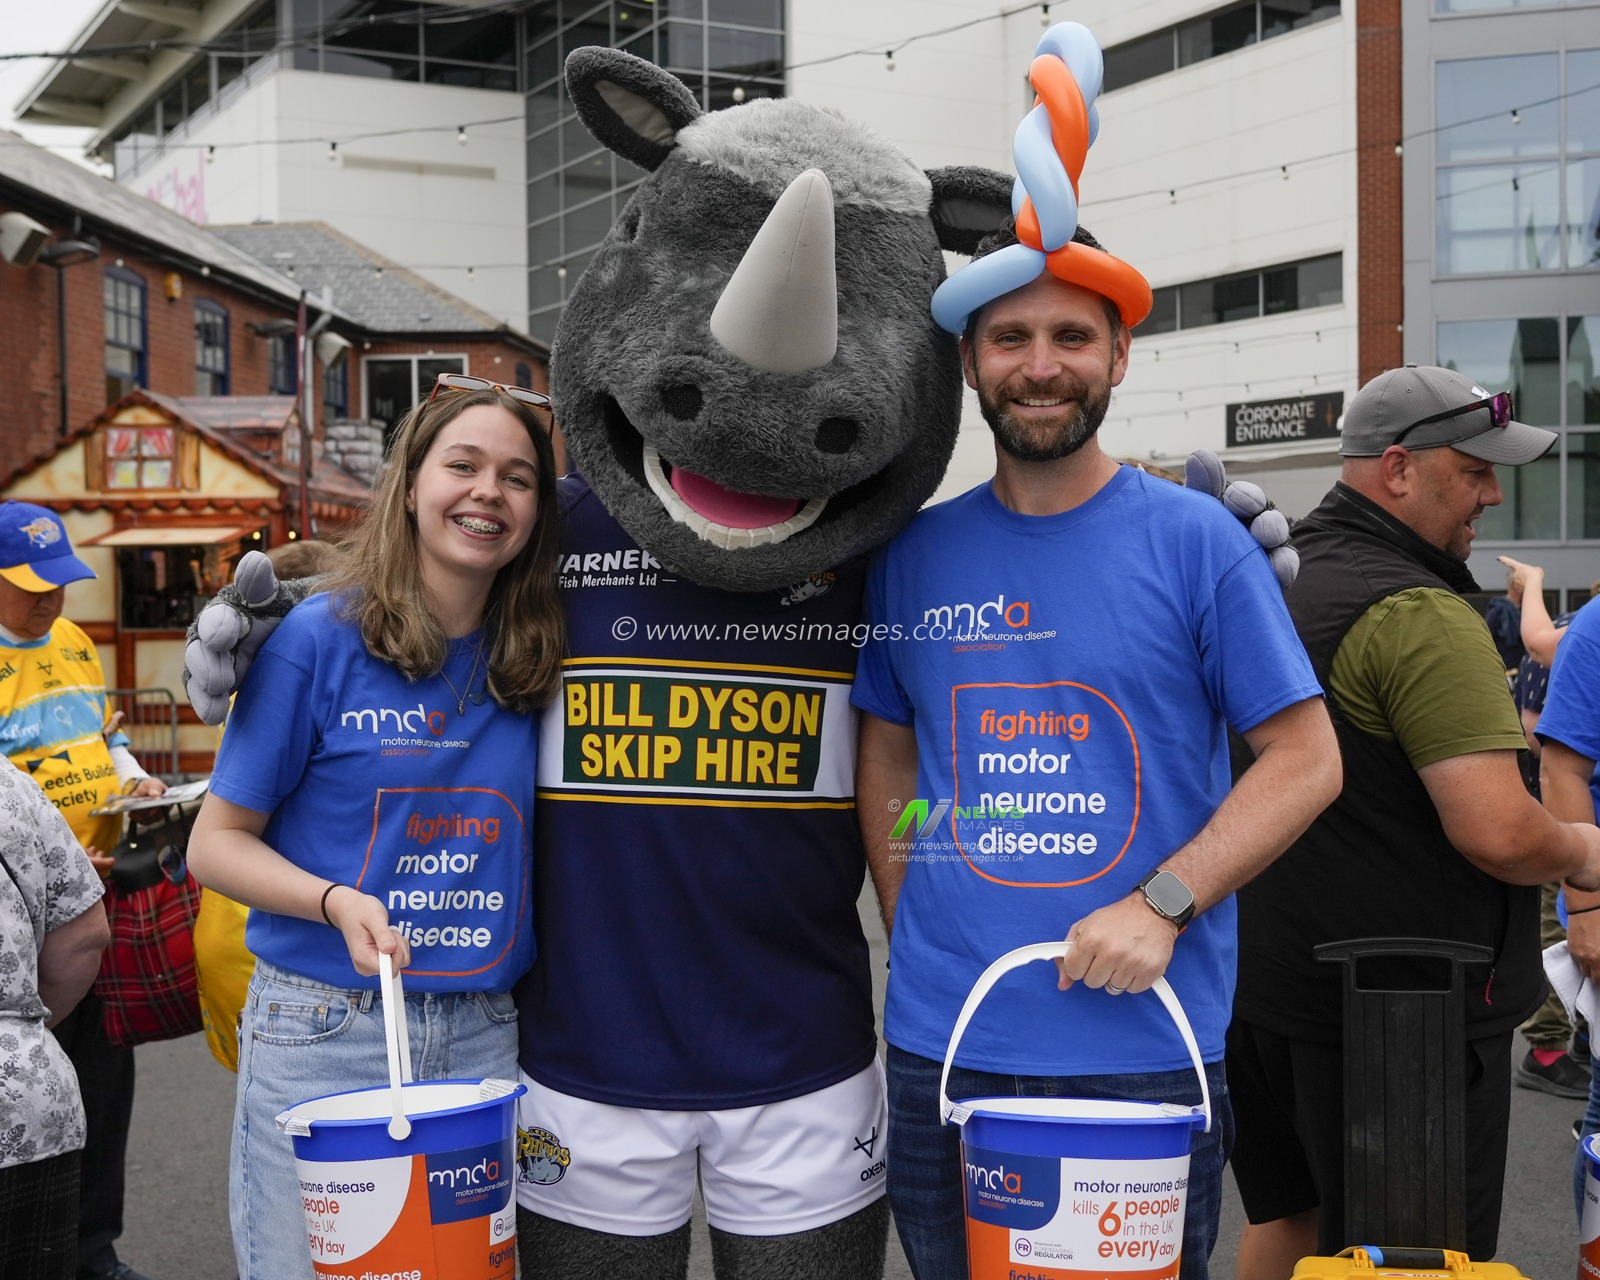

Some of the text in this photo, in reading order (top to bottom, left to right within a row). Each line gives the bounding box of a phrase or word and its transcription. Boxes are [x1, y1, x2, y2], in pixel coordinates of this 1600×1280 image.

[1235, 401, 1316, 425] CORPORATE
[1235, 420, 1307, 442] ENTRANCE
[559, 573, 657, 588] Fish Merchants Ltd
[924, 595, 1030, 630] mnda
[981, 633, 1023, 641] neurone
[1024, 630, 1057, 641] disease
[952, 643, 1006, 653] association
[341, 703, 446, 735] mnda
[566, 682, 821, 737] BILL DYSON
[980, 709, 1090, 741] fighting
[381, 736, 470, 748] motor neurone disease
[580, 733, 801, 785] SKIP HIRE
[978, 747, 1071, 774] motor
[42, 771, 82, 792] eeds
[51, 789, 98, 808] ociety
[979, 792, 1107, 815] neurone
[406, 813, 500, 845] fighting
[978, 827, 1098, 856] disease
[395, 849, 479, 875] motor
[388, 889, 504, 911] neurone
[429, 1157, 499, 1188] mnda
[860, 1158, 886, 1181] OXEN
[965, 1162, 1022, 1194] mnda
[326, 1181, 375, 1193] disease
[1074, 1180, 1121, 1194] motor
[1124, 1180, 1173, 1194] neurone
[1017, 1197, 1045, 1208] disease
[322, 1219, 337, 1233] UK
[1072, 1194, 1180, 1237] kills 6 people
[1123, 1218, 1174, 1236] in the UK
[326, 1240, 345, 1256] day
[1017, 1243, 1029, 1252] FR
[1034, 1250, 1073, 1260] REGULATOR
[1097, 1240, 1176, 1261] every day
